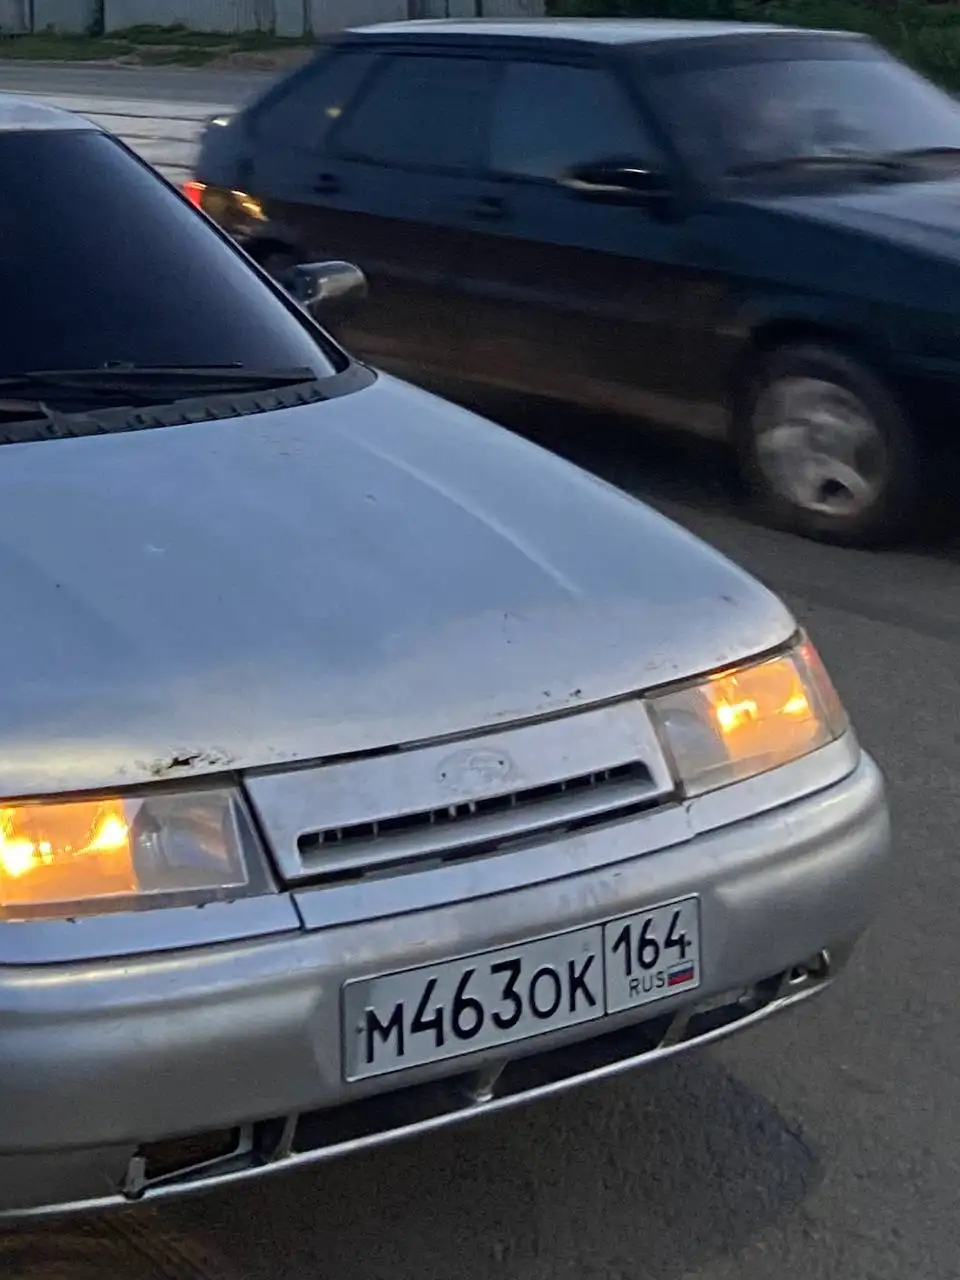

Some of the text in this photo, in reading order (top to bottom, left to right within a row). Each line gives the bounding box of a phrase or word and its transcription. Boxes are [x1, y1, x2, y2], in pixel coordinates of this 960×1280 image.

[364, 910, 686, 1063] М463ОК 164
[628, 970, 665, 998] RUS
